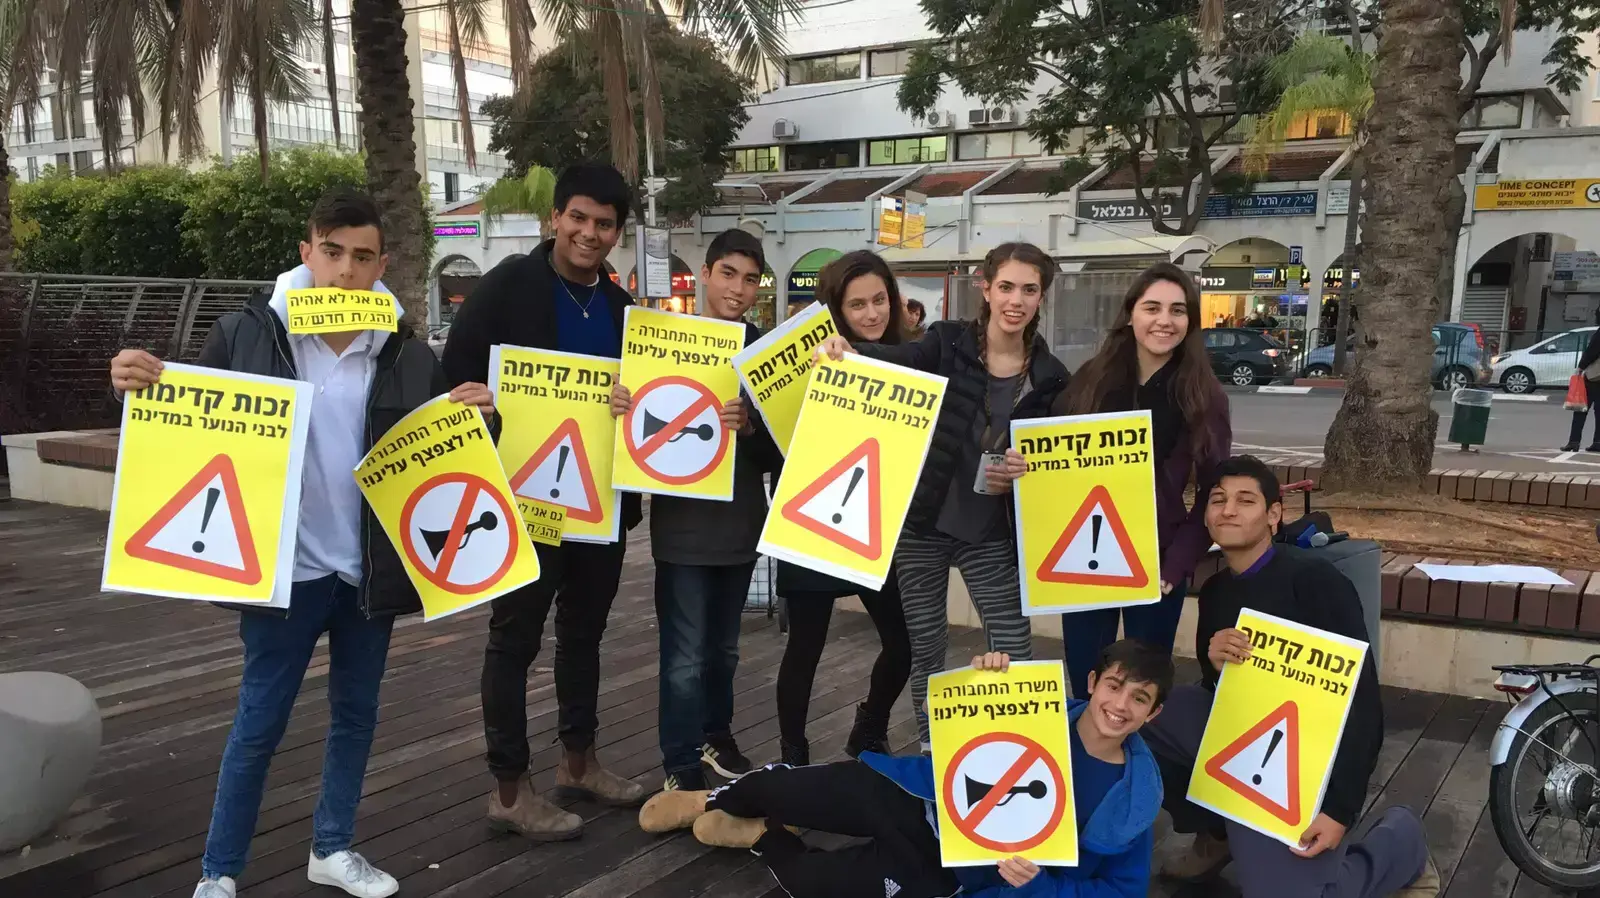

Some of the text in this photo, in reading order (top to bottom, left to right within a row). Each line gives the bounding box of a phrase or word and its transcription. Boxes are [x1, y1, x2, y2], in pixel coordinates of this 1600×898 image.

[1499, 180, 1577, 190] TIME CONCEPT
[1091, 204, 1135, 218] בצלאל
[290, 292, 391, 307] גם אני לא אהיה
[293, 312, 392, 327] נהג/ת חדש/ה
[638, 324, 697, 345] התחבורה
[701, 335, 738, 350] משרד
[627, 341, 667, 359] עלינו!
[671, 349, 719, 367] לצפצף
[747, 319, 835, 387] זכות קדימה
[503, 359, 571, 387] קדימה
[500, 381, 548, 397] במדינה
[551, 387, 588, 402] הנוער
[757, 373, 793, 403] במדינה
[816, 365, 938, 411] זכות קדימה
[231, 392, 291, 418] זכות
[809, 389, 930, 430] לבני הנוער במדינה
[131, 408, 288, 440] לבני הנוער במדינה
[365, 407, 474, 468] משרד התחבורה
[1020, 427, 1147, 456] זכות קדימה
[361, 426, 484, 488] די לצפצף עלינו!
[1073, 454, 1114, 469] הנוער
[1118, 450, 1149, 464] לבני
[531, 506, 547, 518] אני
[550, 512, 563, 522] גם
[1306, 647, 1356, 677] זכות
[1280, 664, 1316, 686] הנוער
[943, 682, 1010, 699] התחבורה
[1014, 680, 1058, 693] משרד
[1319, 677, 1348, 697] לבני
[934, 700, 1060, 720] די לצפצף עלינו!
